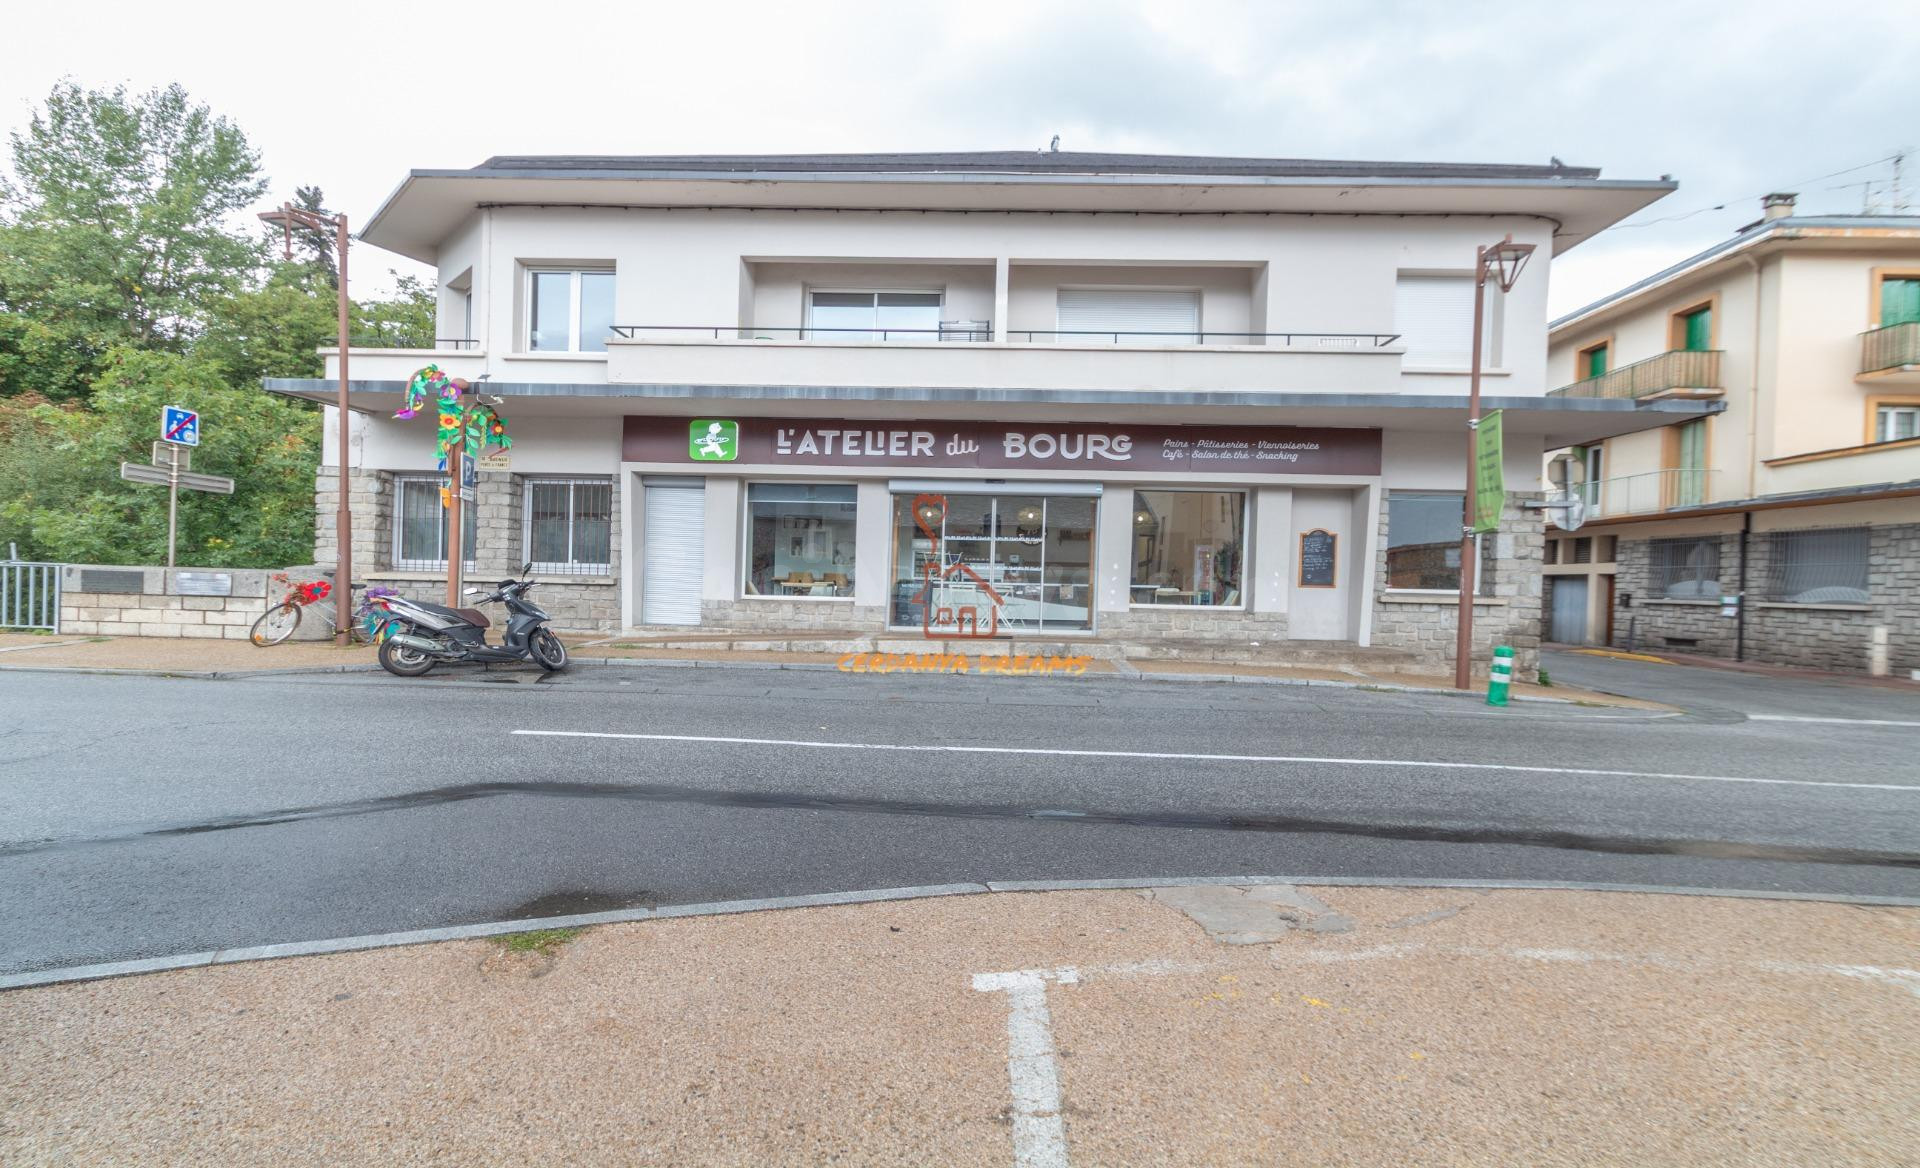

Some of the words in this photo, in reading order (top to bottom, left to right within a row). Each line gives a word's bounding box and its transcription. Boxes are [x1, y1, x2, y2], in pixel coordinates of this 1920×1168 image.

[777, 429, 935, 457] L'ATELIER
[946, 433, 979, 456] du
[1003, 432, 1133, 461] BOURG
[1163, 438, 1188, 448] Pains
[1197, 439, 1248, 449] Pâtisseries
[1257, 440, 1319, 450] Viennoiseries
[1162, 449, 1183, 460] Café
[1191, 449, 1219, 459] Salon
[1220, 450, 1232, 459] de
[1233, 450, 1249, 459] thé
[1255, 450, 1298, 462] Snacking
